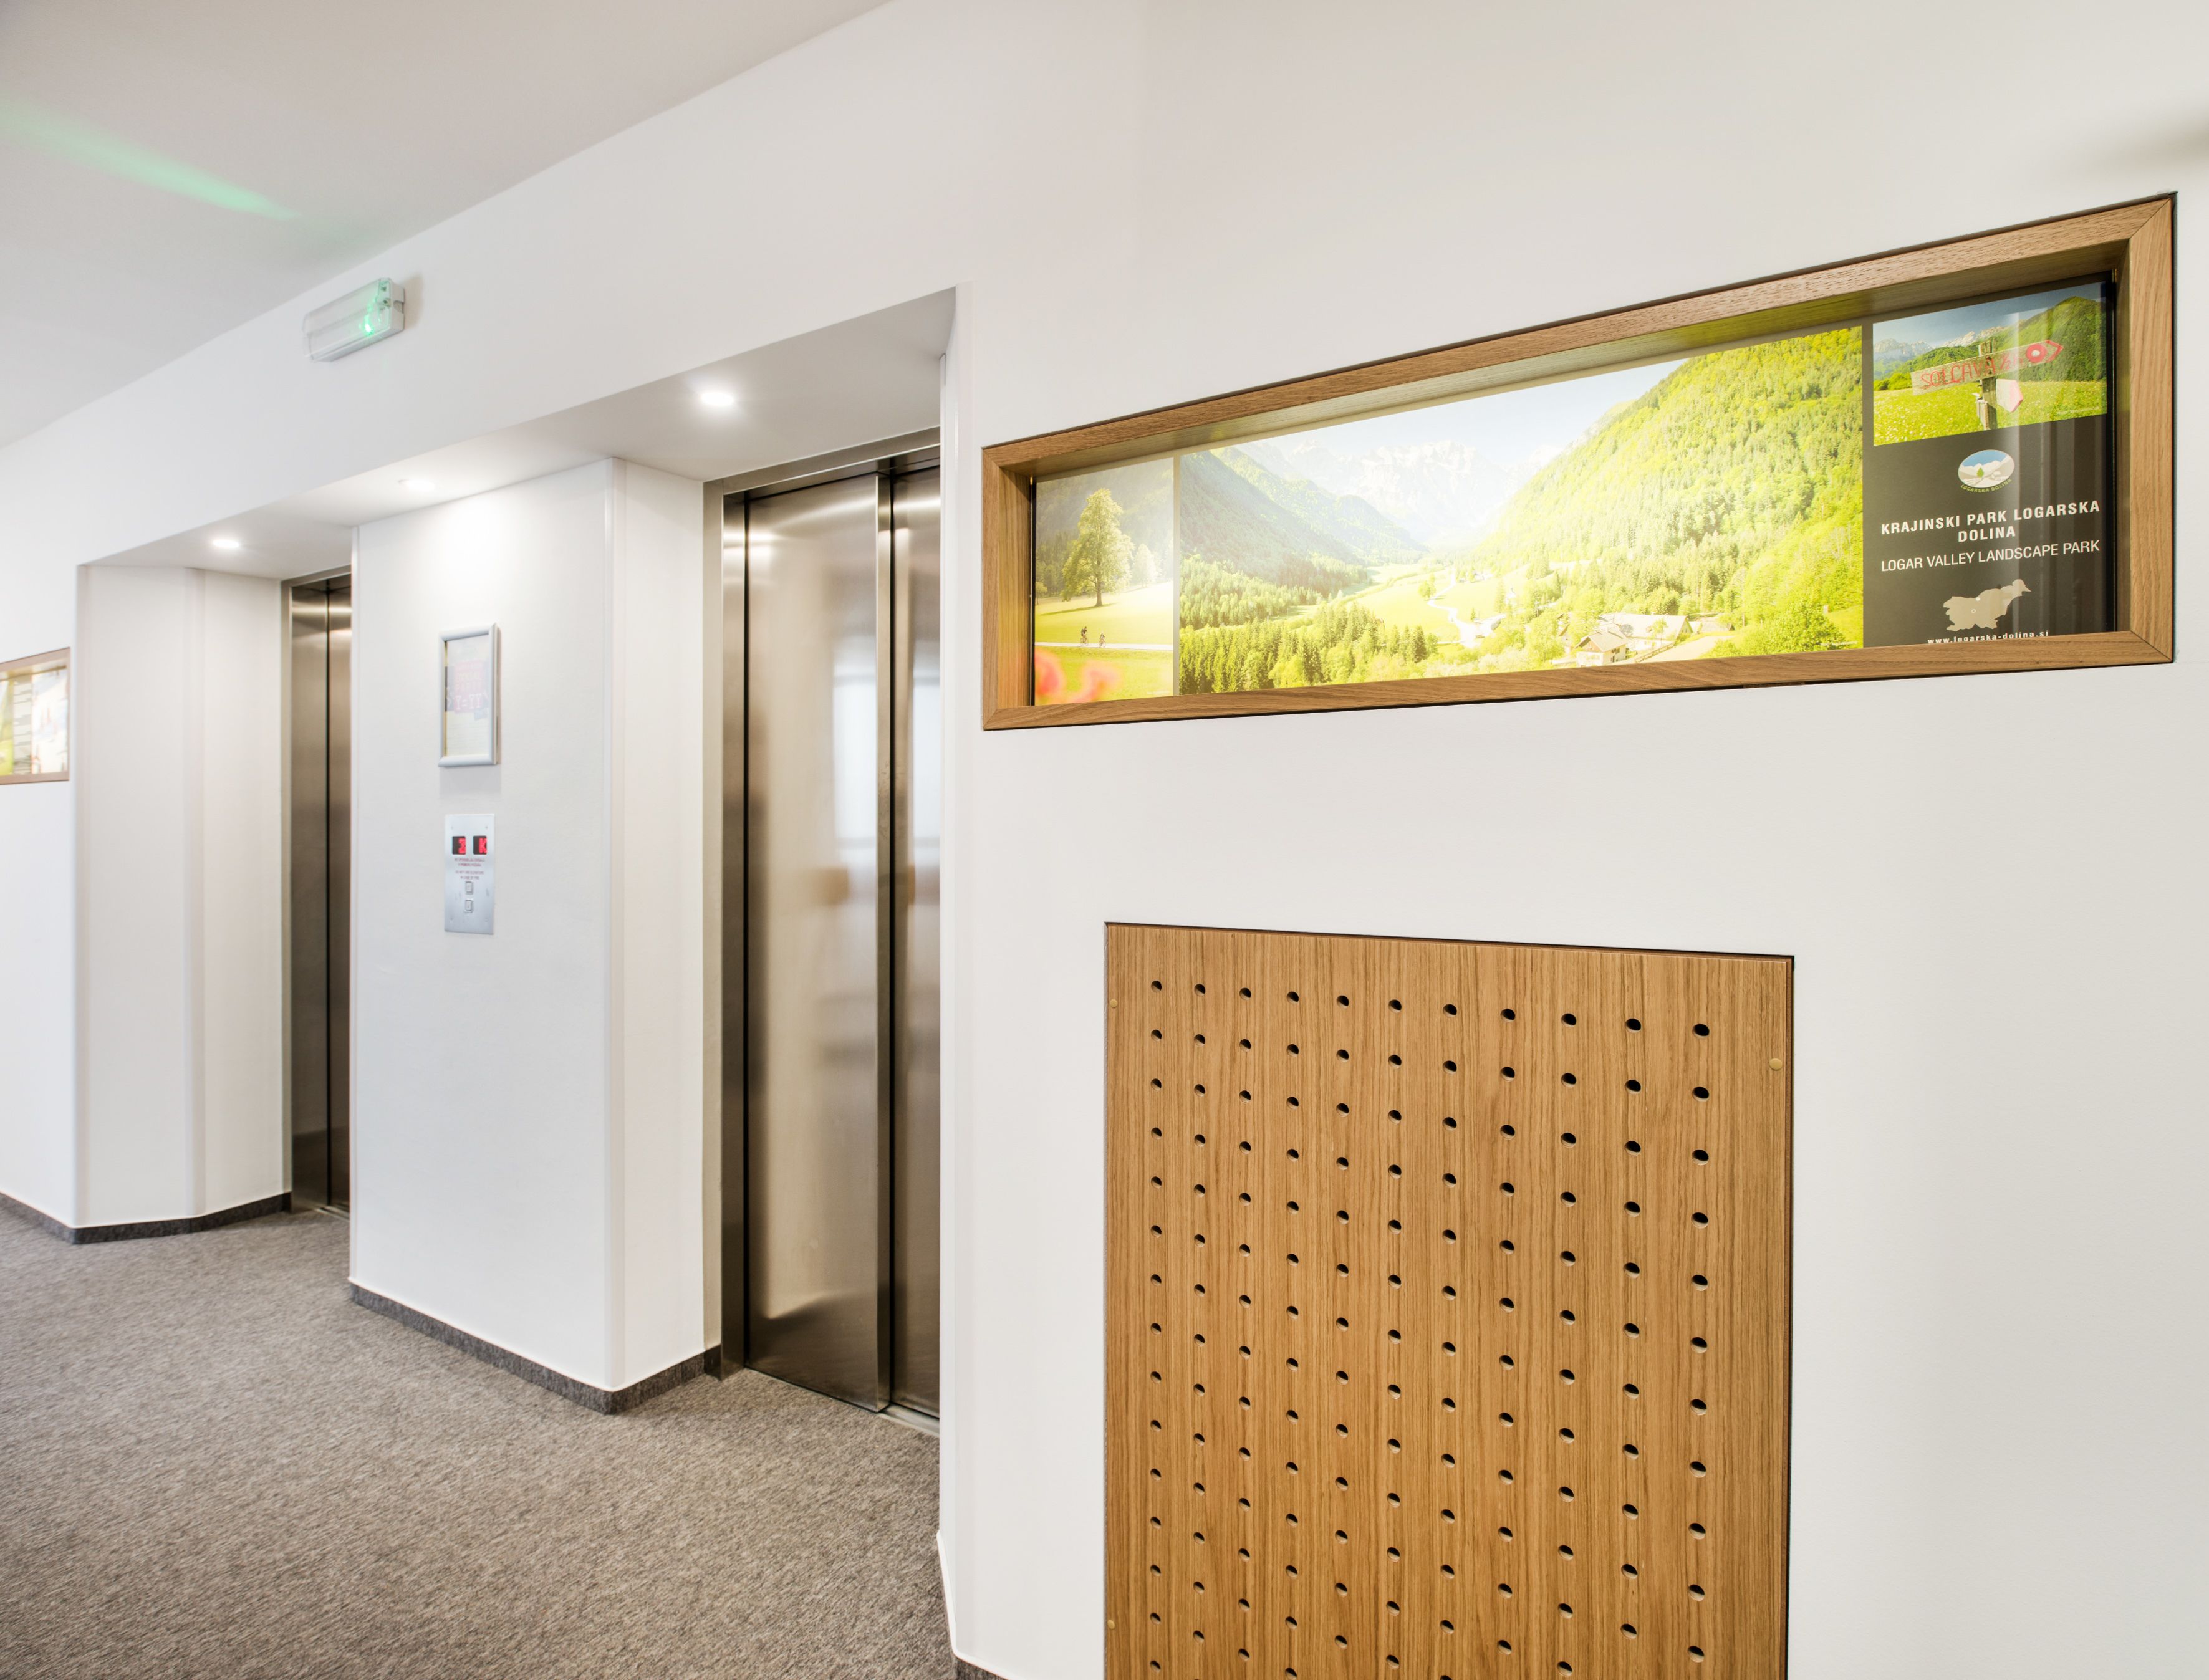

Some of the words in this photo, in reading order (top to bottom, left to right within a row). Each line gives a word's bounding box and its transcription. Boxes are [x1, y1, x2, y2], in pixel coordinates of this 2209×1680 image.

[1960, 484, 1990, 493] LOGARSKA
[1991, 478, 2012, 491] DOLINA
[1881, 516, 1960, 535] KRAJINSKI
[1967, 511, 2007, 526] PARK
[2014, 500, 2100, 521] LOGARSKA
[1958, 526, 2016, 542] DOLINA
[1881, 557, 1923, 572] LOGAR
[1927, 551, 1975, 567] VALLEY
[1978, 544, 2059, 562] LANDSCAPE
[2063, 539, 2101, 554] PARK
